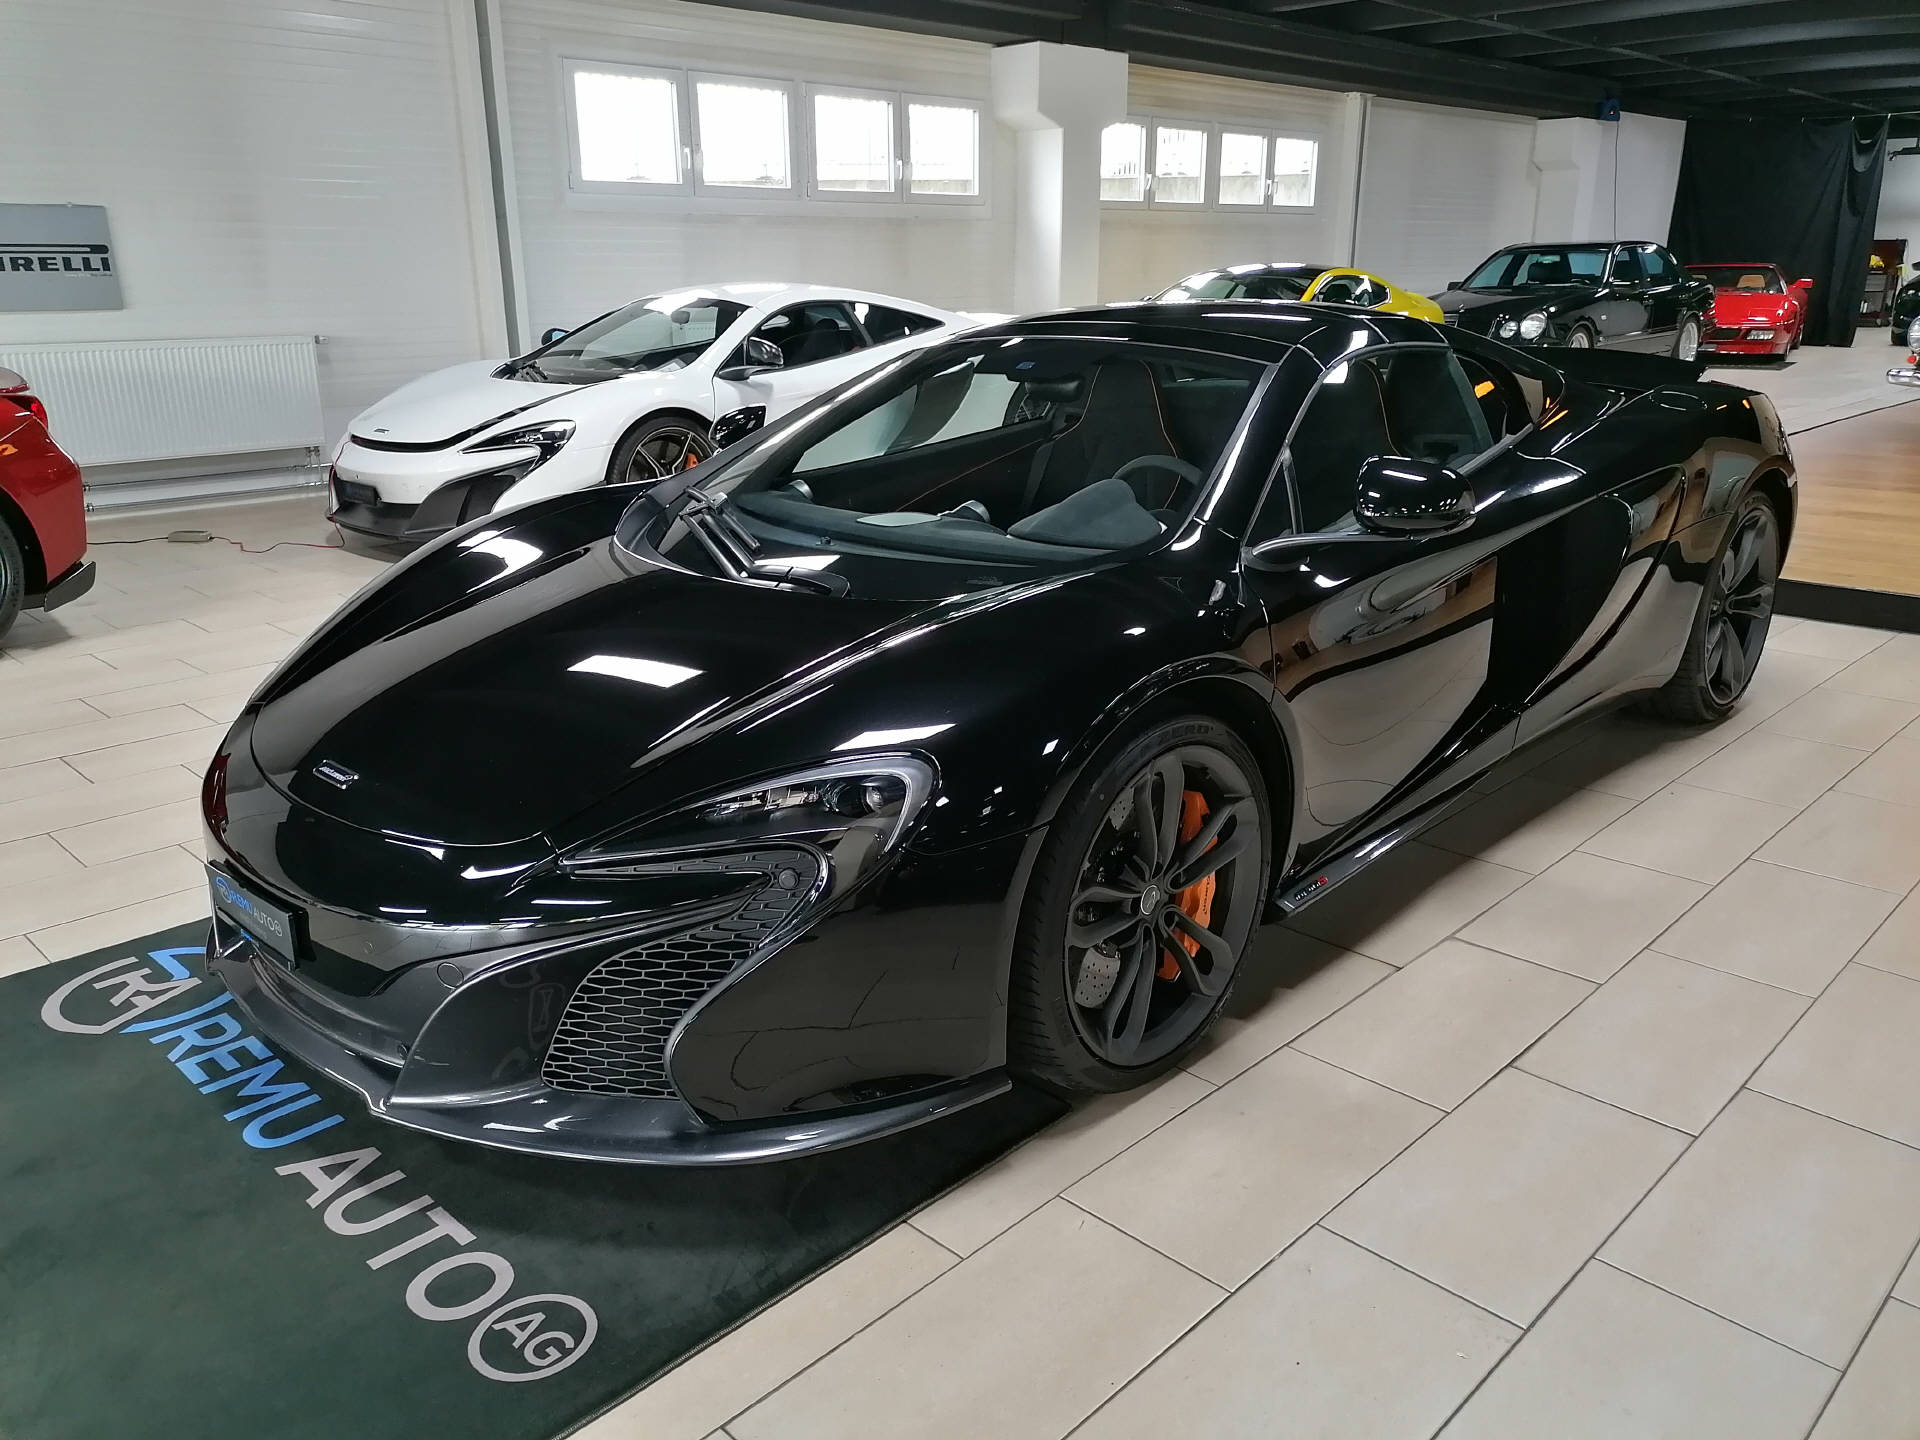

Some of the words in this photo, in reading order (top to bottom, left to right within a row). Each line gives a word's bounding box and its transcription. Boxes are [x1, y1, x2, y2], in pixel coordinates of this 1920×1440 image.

[0, 256, 111, 272] IRELLI
[148, 1012, 345, 1149] REMU
[274, 1147, 515, 1321] AUTO
[492, 1311, 575, 1367] AG
